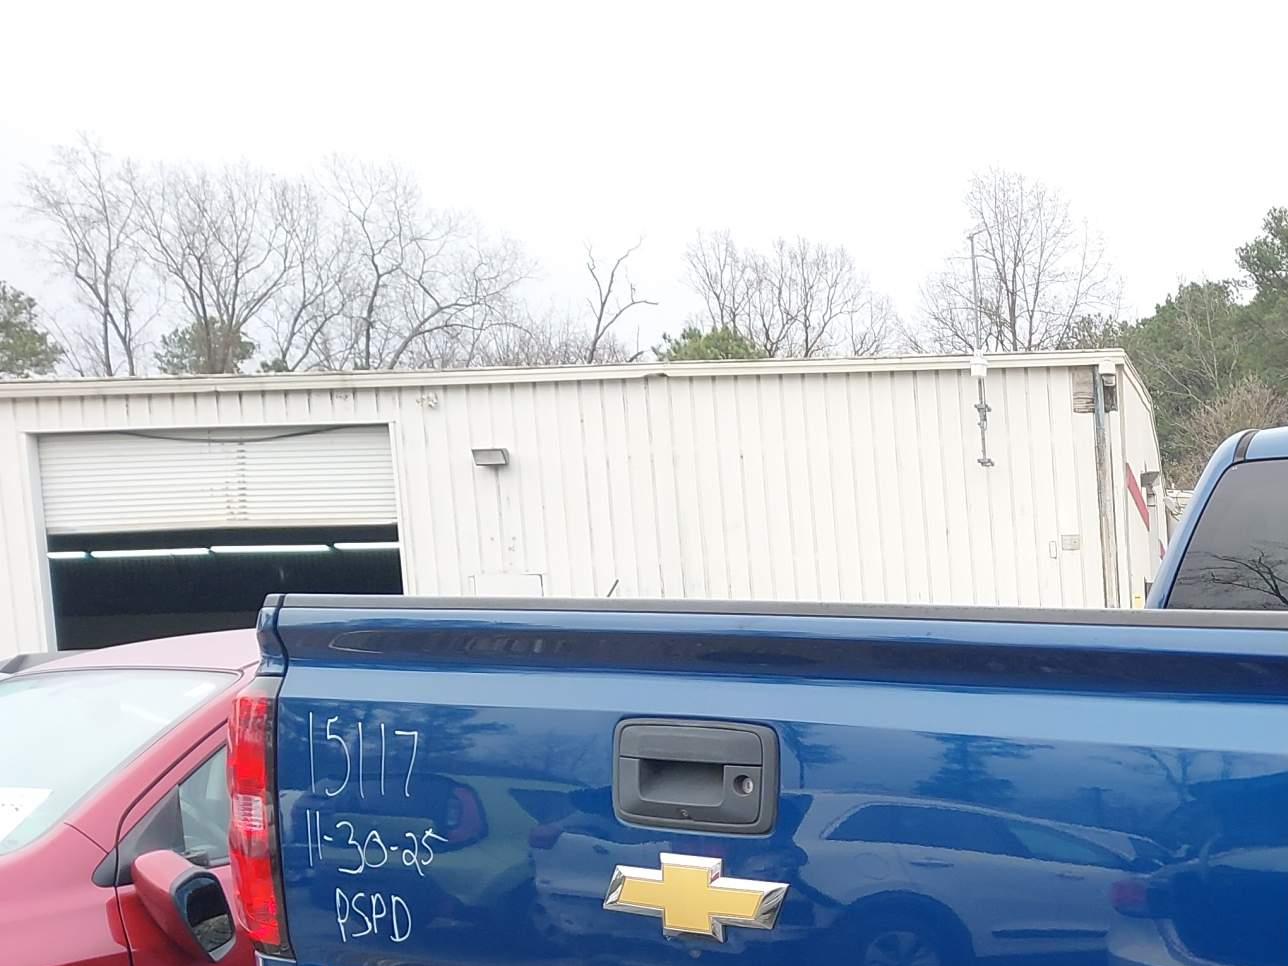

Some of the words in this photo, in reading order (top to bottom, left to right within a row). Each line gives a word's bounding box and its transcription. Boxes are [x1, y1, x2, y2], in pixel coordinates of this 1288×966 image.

[308, 710, 419, 798] 15117
[305, 808, 449, 877] 11-30-25
[335, 887, 412, 942] PSPD
